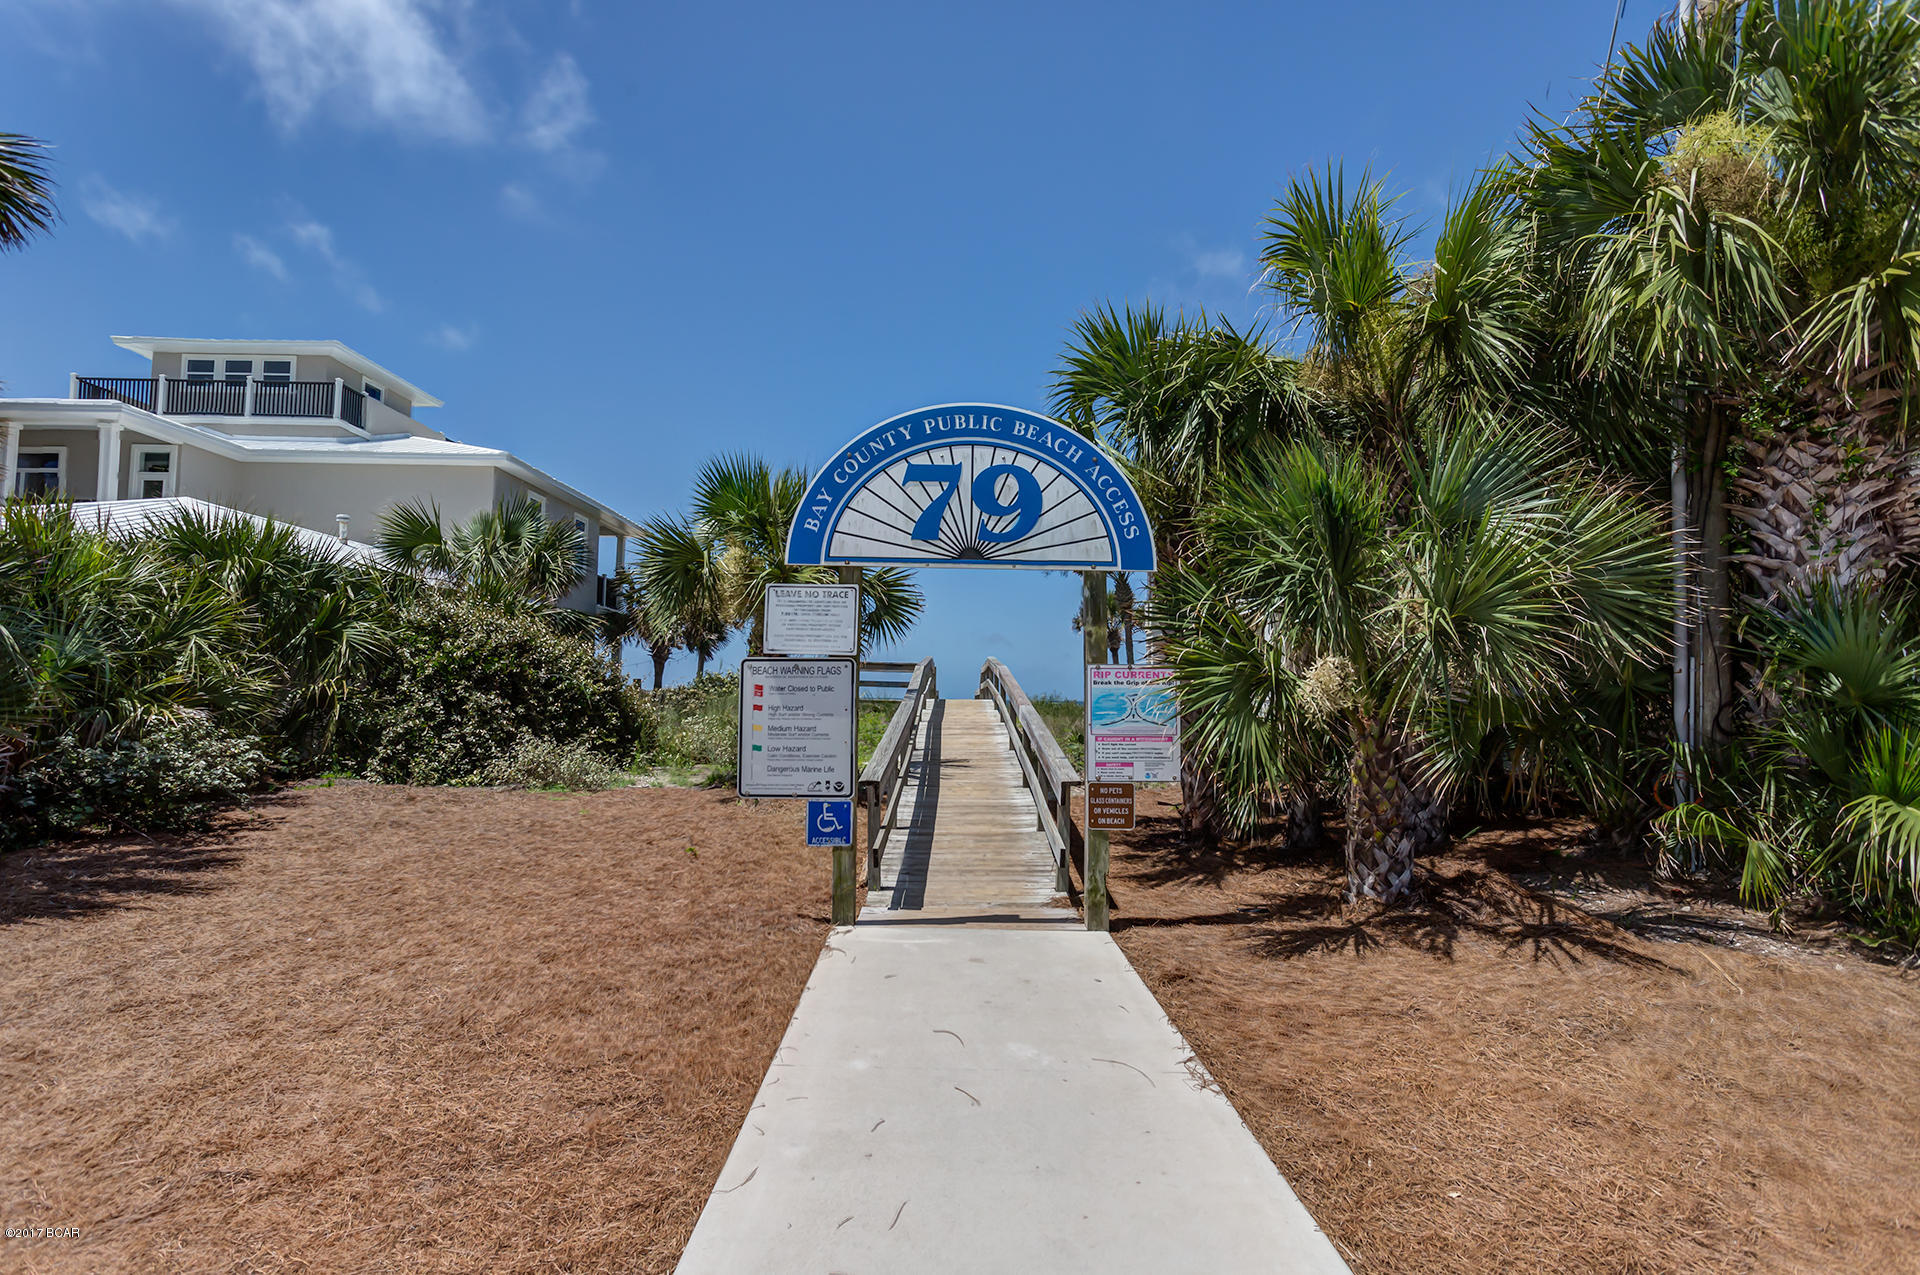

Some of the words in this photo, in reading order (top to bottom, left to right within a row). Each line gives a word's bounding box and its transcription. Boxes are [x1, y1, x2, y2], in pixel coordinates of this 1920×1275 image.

[803, 487, 833, 533] BAY
[833, 424, 913, 485] COUNTY
[922, 414, 1003, 434] PUBLIC
[1012, 420, 1084, 465] BEACH
[1084, 464, 1140, 541] ACCESS
[901, 461, 1044, 543] 79
[775, 590, 802, 598] LEAVE
[805, 590, 820, 598] NO
[822, 590, 849, 599] TRACE
[752, 666, 778, 675] BEACH
[780, 666, 815, 675] WARNING
[817, 666, 842, 675] FLAGS
[1093, 671, 1111, 679] RIP
[769, 684, 786, 692] Water
[788, 684, 809, 692] Closed
[817, 684, 835, 692] Public
[768, 704, 780, 712] High
[767, 765, 800, 773] Dangerous
[801, 765, 822, 773] Marine
[1102, 807, 1129, 815] VEHICLES
